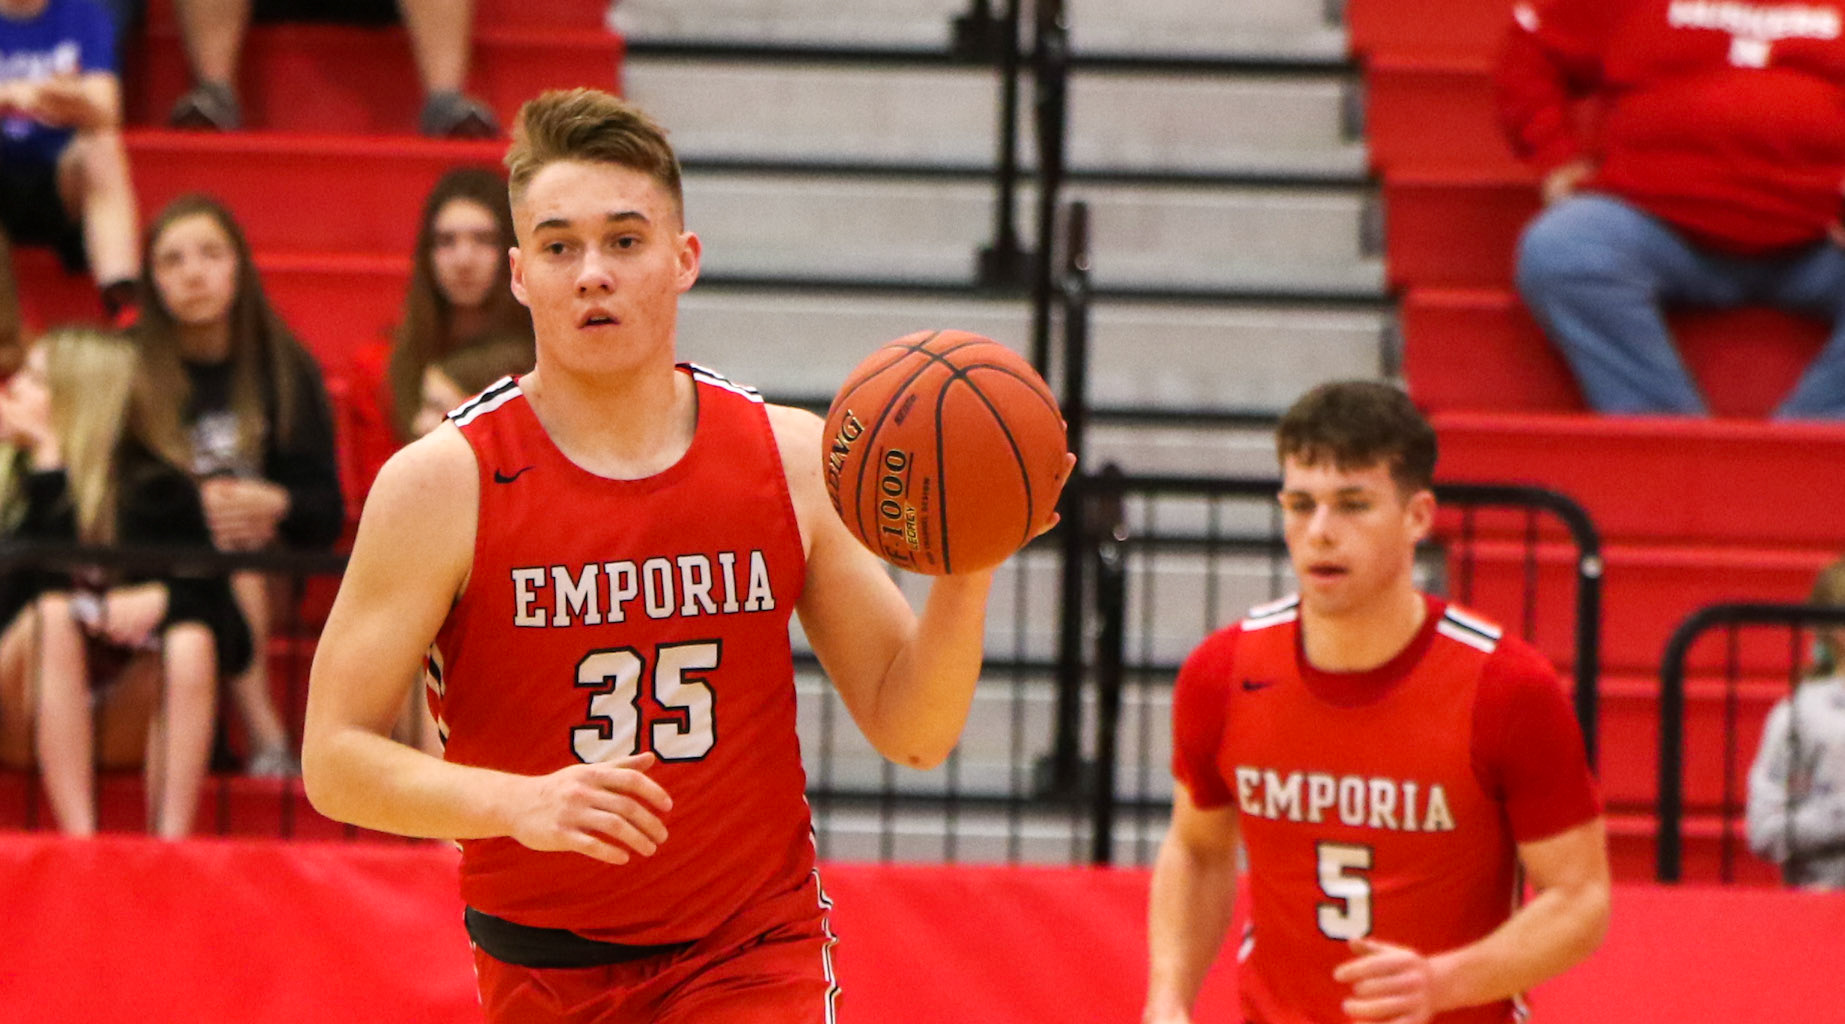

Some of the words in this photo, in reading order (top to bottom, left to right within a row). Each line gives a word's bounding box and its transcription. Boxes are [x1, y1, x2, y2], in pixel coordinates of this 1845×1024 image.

[880, 448, 908, 563] F-1000
[511, 549, 776, 628] EMPORIA
[570, 638, 723, 764] 35
[1235, 764, 1456, 832] EMPORIA
[1316, 839, 1374, 941] 5
